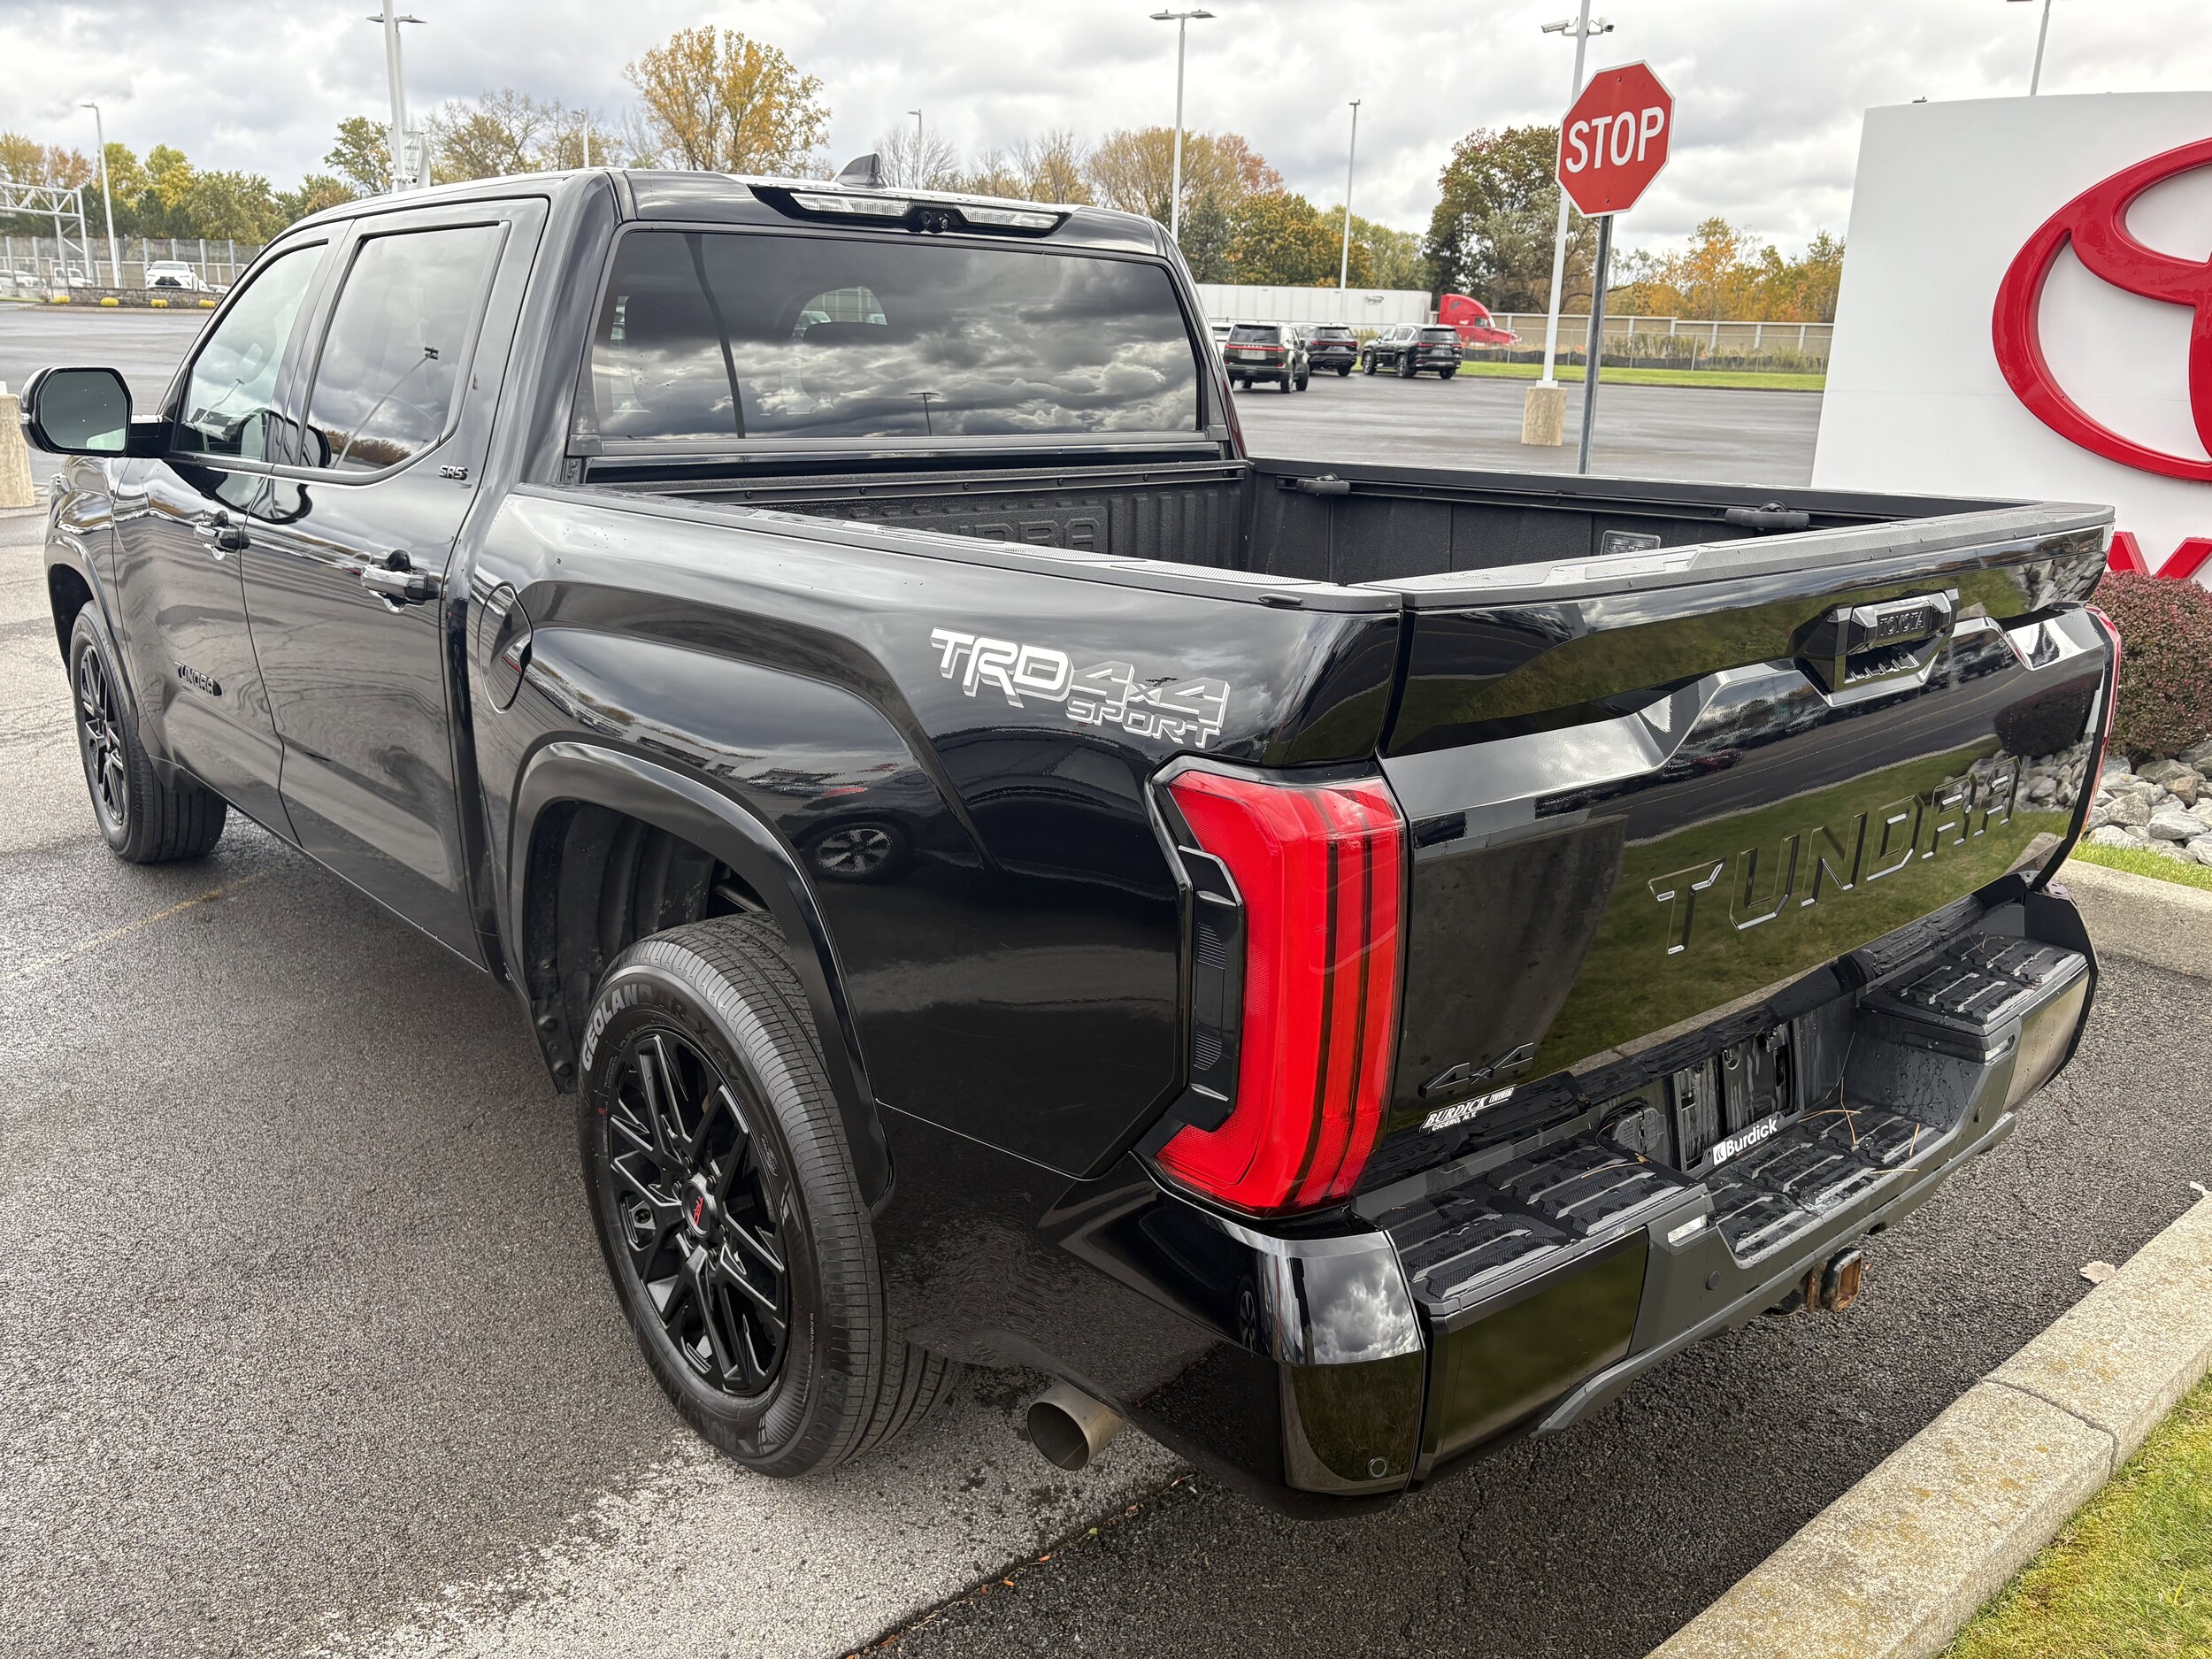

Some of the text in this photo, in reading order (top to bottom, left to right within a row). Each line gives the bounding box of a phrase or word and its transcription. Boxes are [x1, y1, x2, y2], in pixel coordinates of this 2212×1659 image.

[1565, 106, 1665, 173] STOP
[438, 465, 468, 480] SR5
[1879, 611, 1924, 636] TOYOTA
[174, 661, 217, 695] TUNDRA
[929, 626, 1232, 728] TRD 4x4
[1065, 695, 1221, 749] SPORT
[1647, 755, 2024, 955] TUNDRA
[1417, 1042, 1534, 1099] 4x4
[1423, 1094, 1491, 1126] BURDICK
[1431, 1117, 1462, 1132] CICERO,
[1726, 1118, 1778, 1157] Burdick
